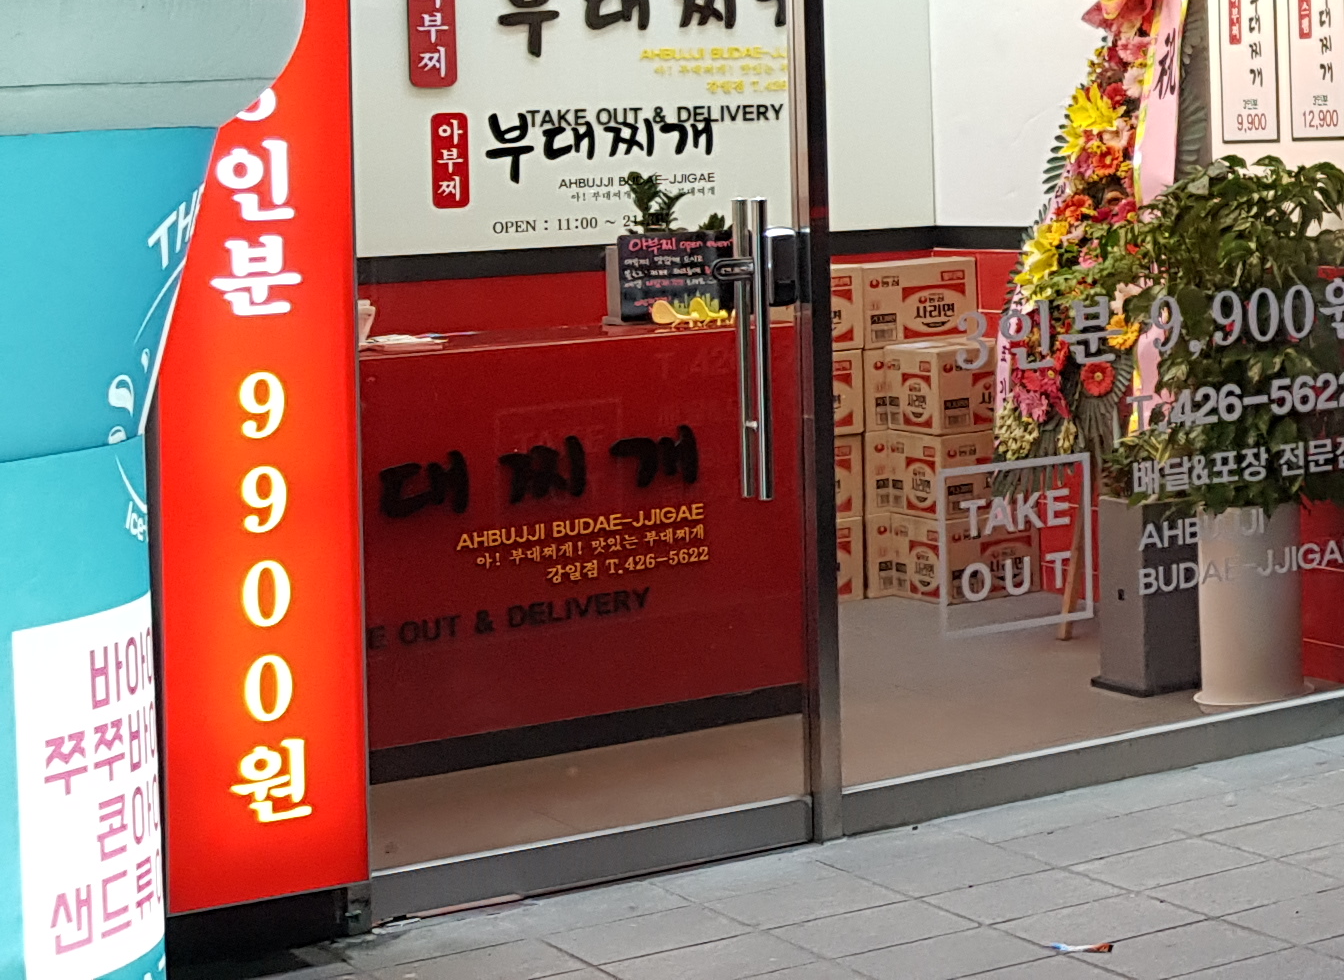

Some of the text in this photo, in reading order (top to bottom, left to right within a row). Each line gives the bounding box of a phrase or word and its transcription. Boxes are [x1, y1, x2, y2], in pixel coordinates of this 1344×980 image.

[526, 104, 784, 127] TAKE OUT & DELIVERY
[1237, 113, 1267, 133] 9,900
[1302, 110, 1339, 131] 12,900
[438, 119, 463, 202] 아부찌
[485, 112, 714, 184] 부대찌개
[209, 87, 302, 316] 인분
[559, 177, 614, 189] AHBUJJI
[493, 219, 536, 234] OPEN
[557, 216, 598, 231] 11:00
[628, 237, 677, 255] 아부찌
[914, 303, 955, 319] 사리면
[956, 295, 1124, 371] 3인분
[1132, 448, 1269, 496] 배달&포장
[457, 503, 704, 552] AHBUJJI BUDAE-JJIGAE
[960, 488, 1071, 538] TAKE
[476, 523, 705, 570] 아! 부대찌개! 맛있는 부대찌개
[547, 546, 709, 585] 강일점 T.426-5622
[230, 372, 312, 823] 9900원
[960, 550, 1073, 602] OUT
[400, 586, 652, 646] OUT & DELIVERY
